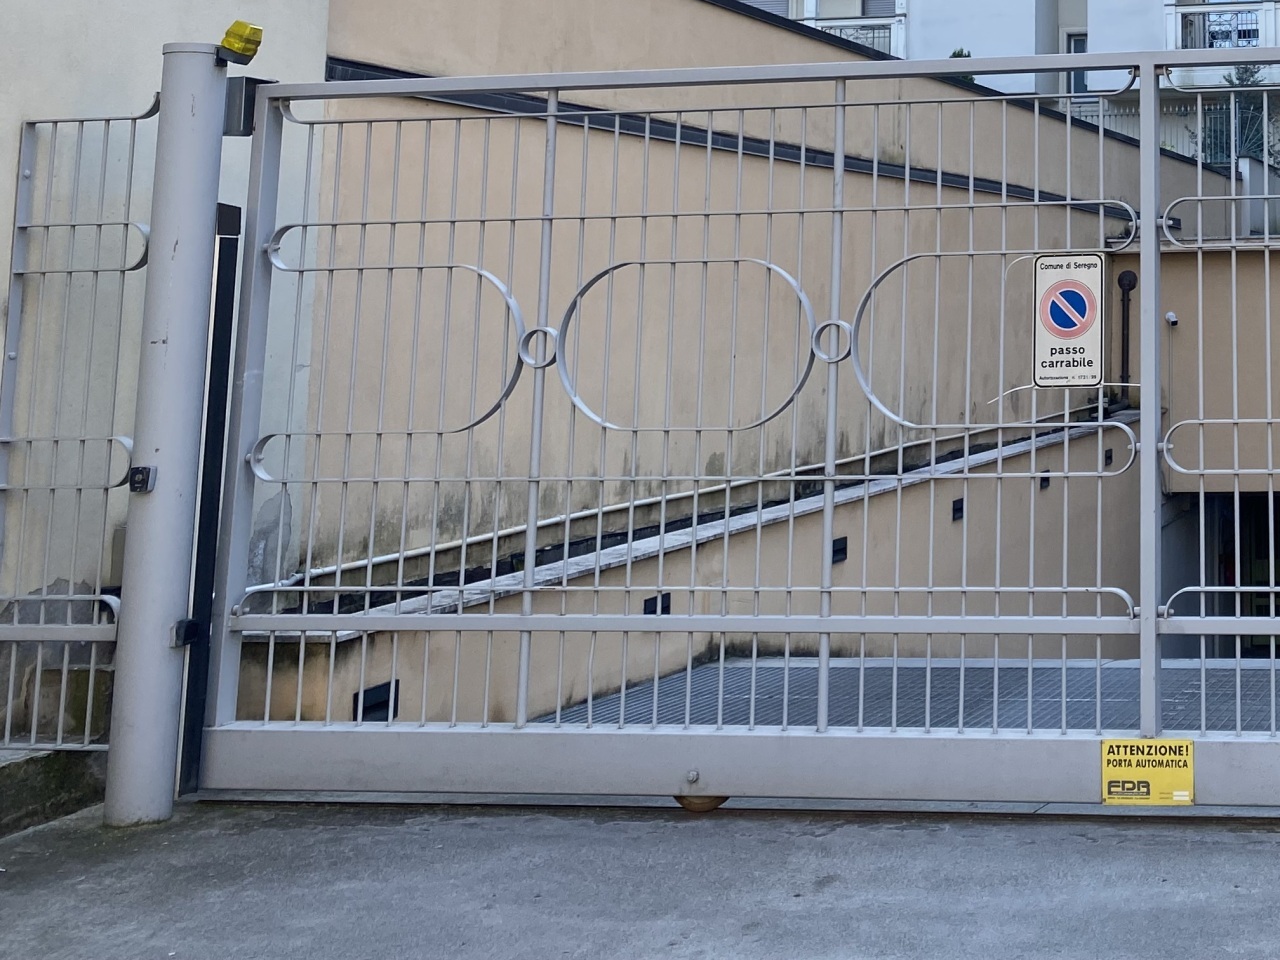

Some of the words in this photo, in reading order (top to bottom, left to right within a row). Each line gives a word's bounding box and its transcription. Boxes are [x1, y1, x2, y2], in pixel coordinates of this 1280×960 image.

[1040, 262, 1064, 270] Comune
[1074, 261, 1098, 270] Seregno
[1050, 346, 1085, 357] passo
[1041, 357, 1093, 368] carrabile
[1107, 745, 1189, 756] ATTENZIONE!
[1107, 759, 1133, 768] PORTA
[1135, 759, 1188, 768] AUTOMATICA
